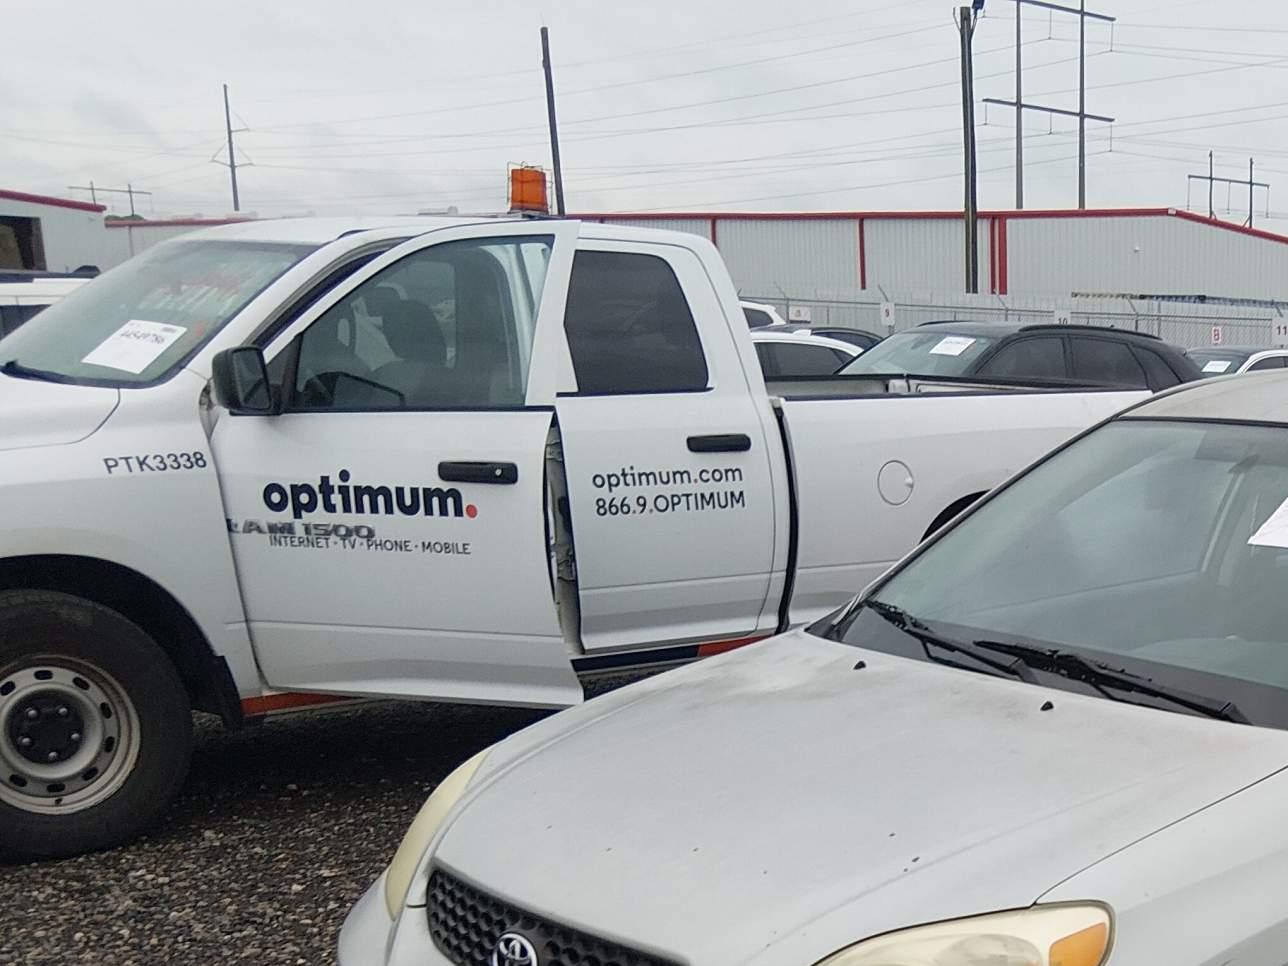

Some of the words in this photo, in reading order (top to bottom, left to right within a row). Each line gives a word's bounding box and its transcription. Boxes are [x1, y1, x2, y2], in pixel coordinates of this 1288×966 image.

[1276, 326, 1288, 336] 11
[103, 451, 207, 474] PTK3338
[592, 465, 743, 493] optimum.com
[595, 490, 746, 516] 866.9.OPTIMUM
[302, 522, 376, 539] 1500
[269, 535, 330, 548] INTERNET
[341, 538, 356, 549] TV
[366, 538, 413, 552] PHONE
[421, 541, 471, 555] MOBILE
